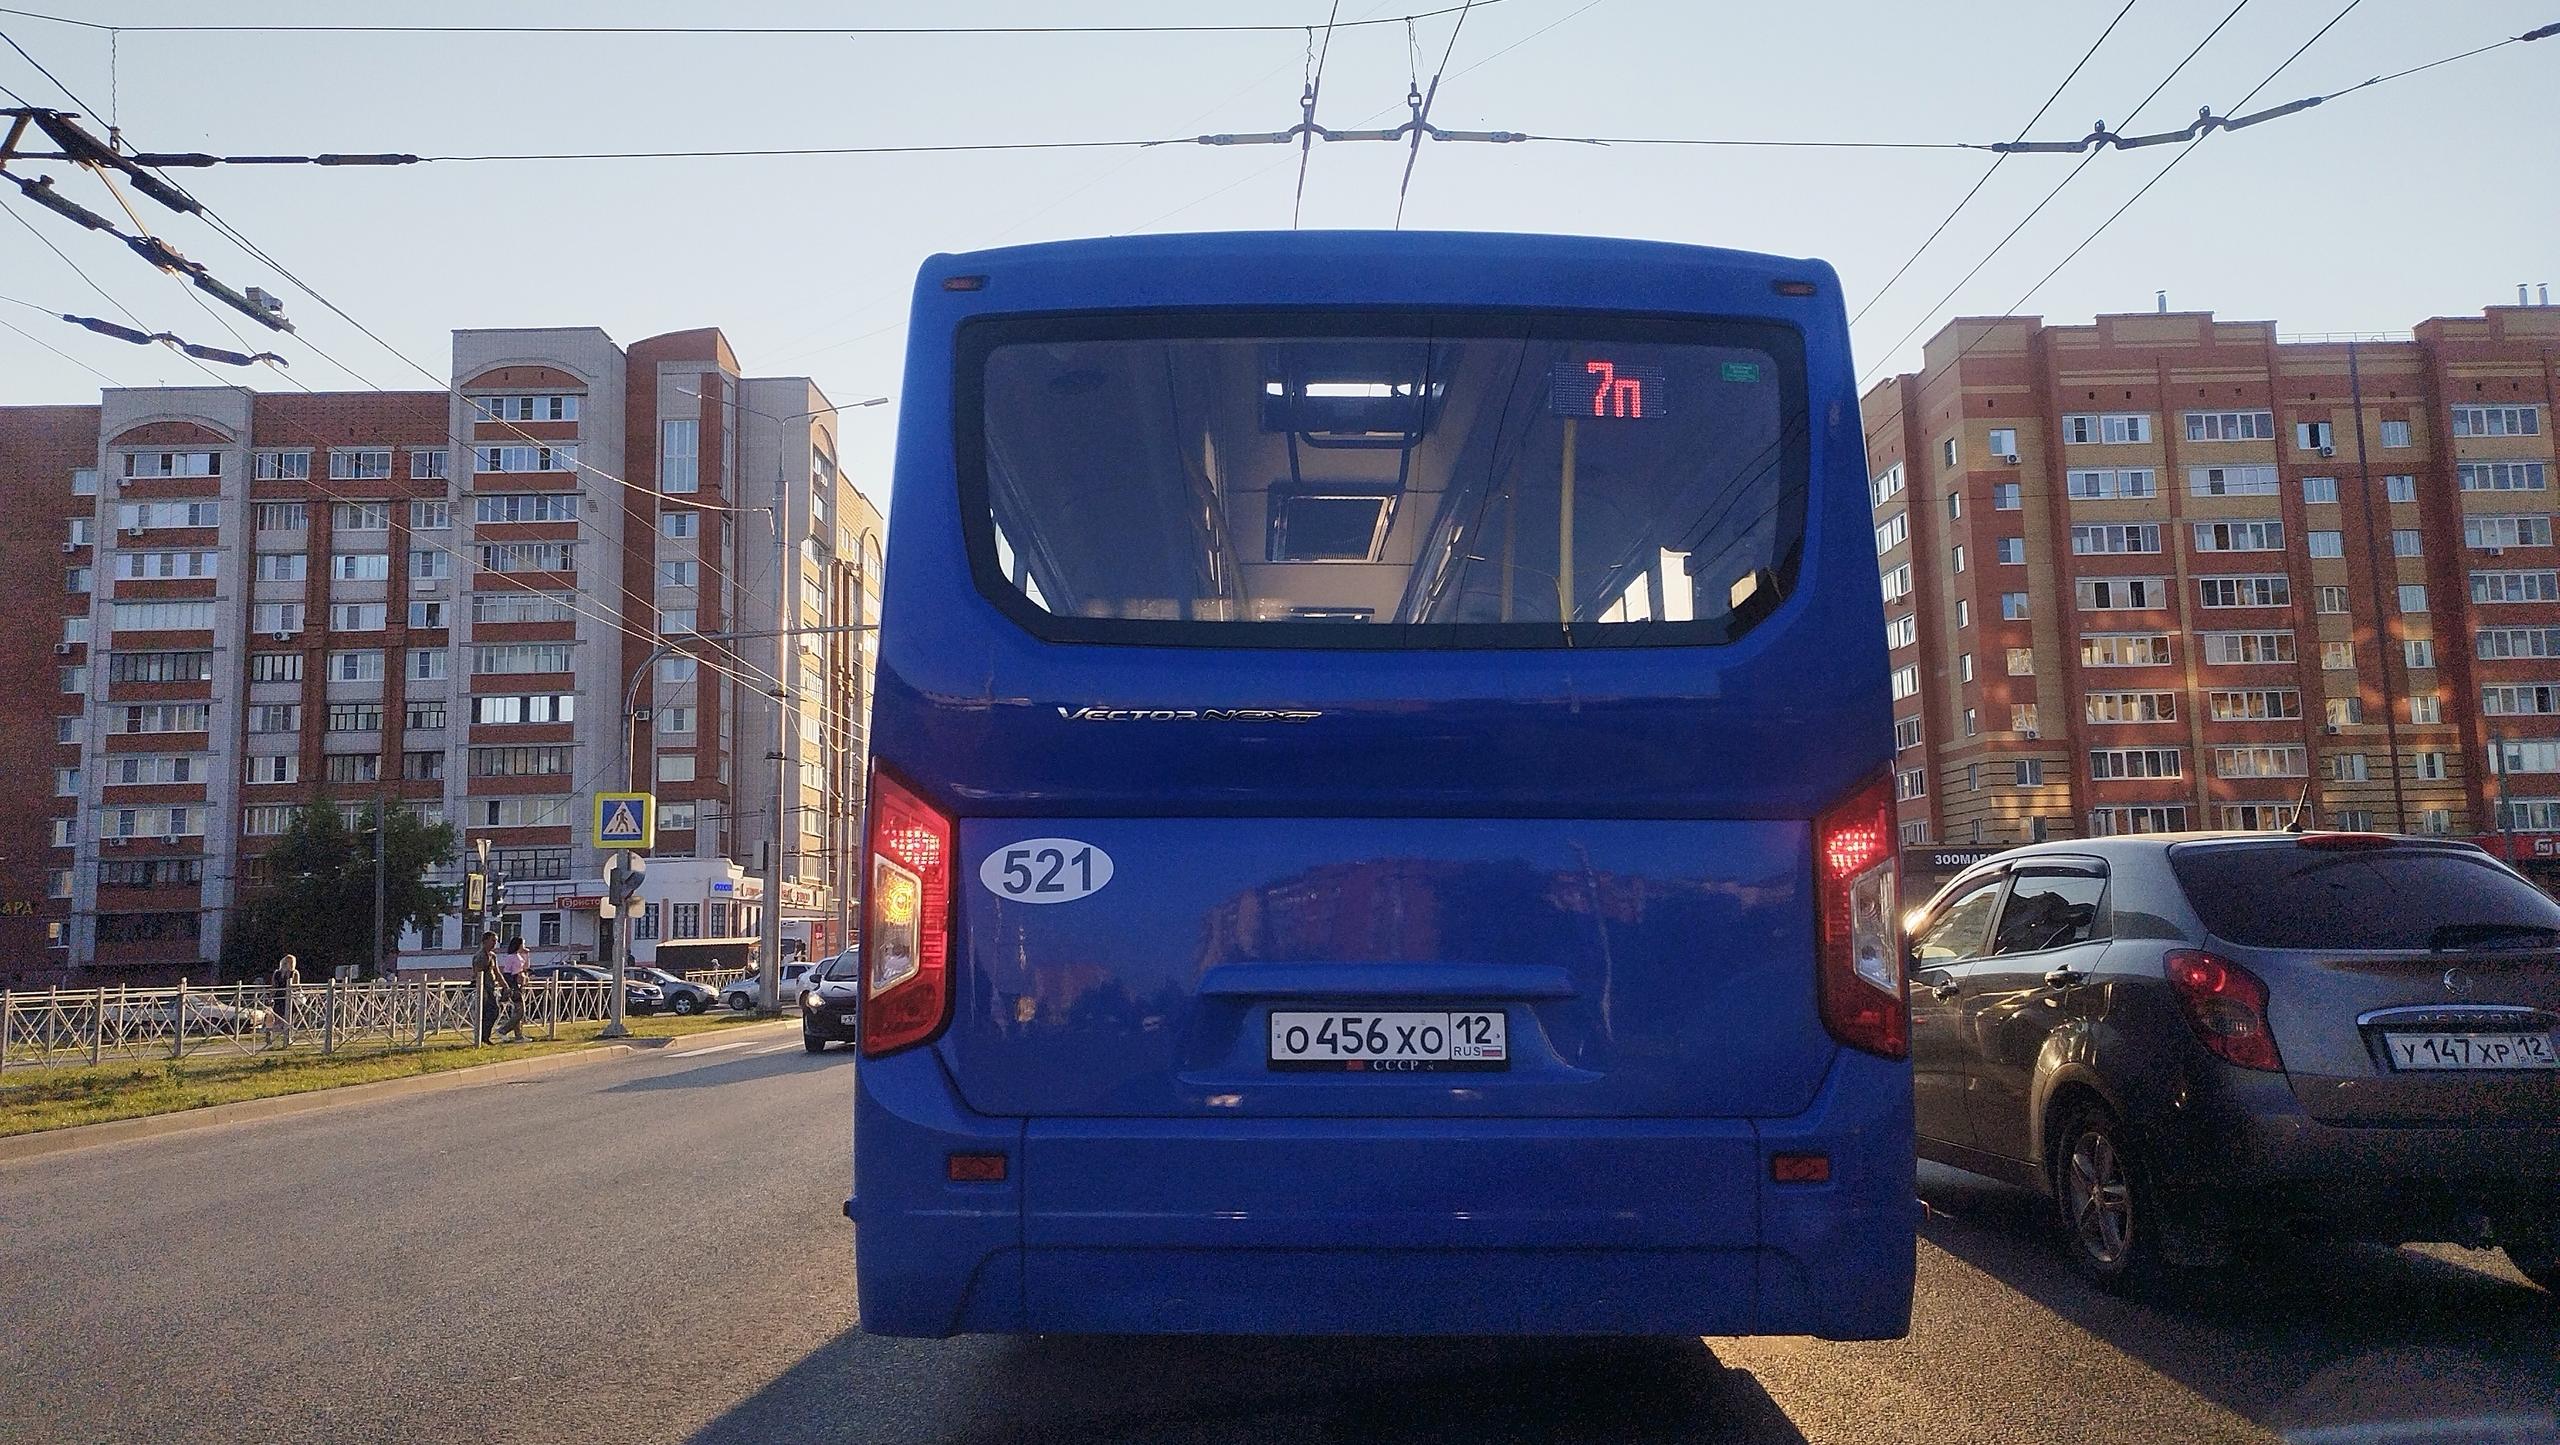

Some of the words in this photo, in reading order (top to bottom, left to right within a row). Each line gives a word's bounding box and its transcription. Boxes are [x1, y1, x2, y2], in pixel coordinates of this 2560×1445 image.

[1056, 706, 1198, 721] VECTOR
[1003, 847, 1091, 894] 521
[562, 897, 601, 908] Бристо
[1456, 1015, 1492, 1044] 12
[1453, 1046, 1481, 1057] RUS
[2517, 1037, 2546, 1056] 12
[1373, 1060, 1419, 1071] СССР
